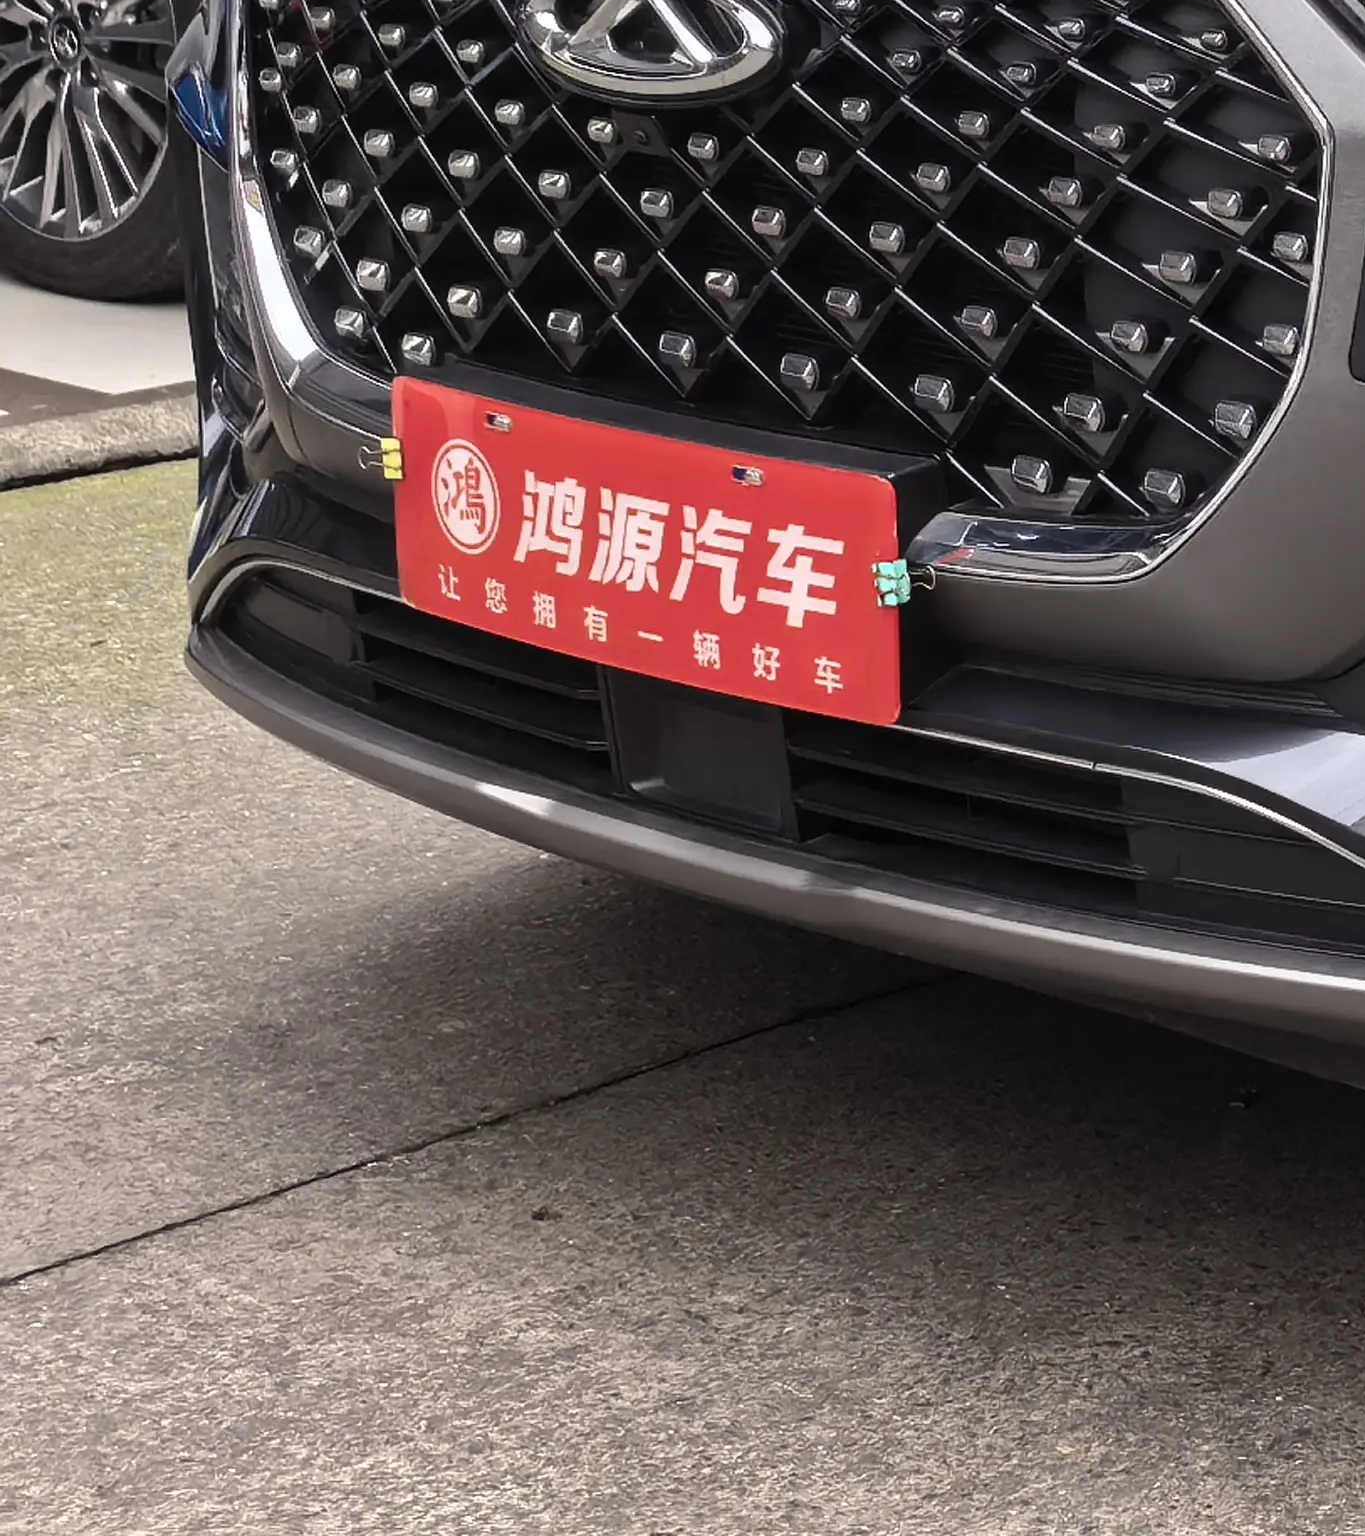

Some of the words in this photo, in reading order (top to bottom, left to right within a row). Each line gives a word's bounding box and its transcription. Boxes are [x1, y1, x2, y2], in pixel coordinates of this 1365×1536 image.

[513, 469, 845, 629] 鸿源汽车
[437, 564, 844, 695] 让您拥有一辆好车
